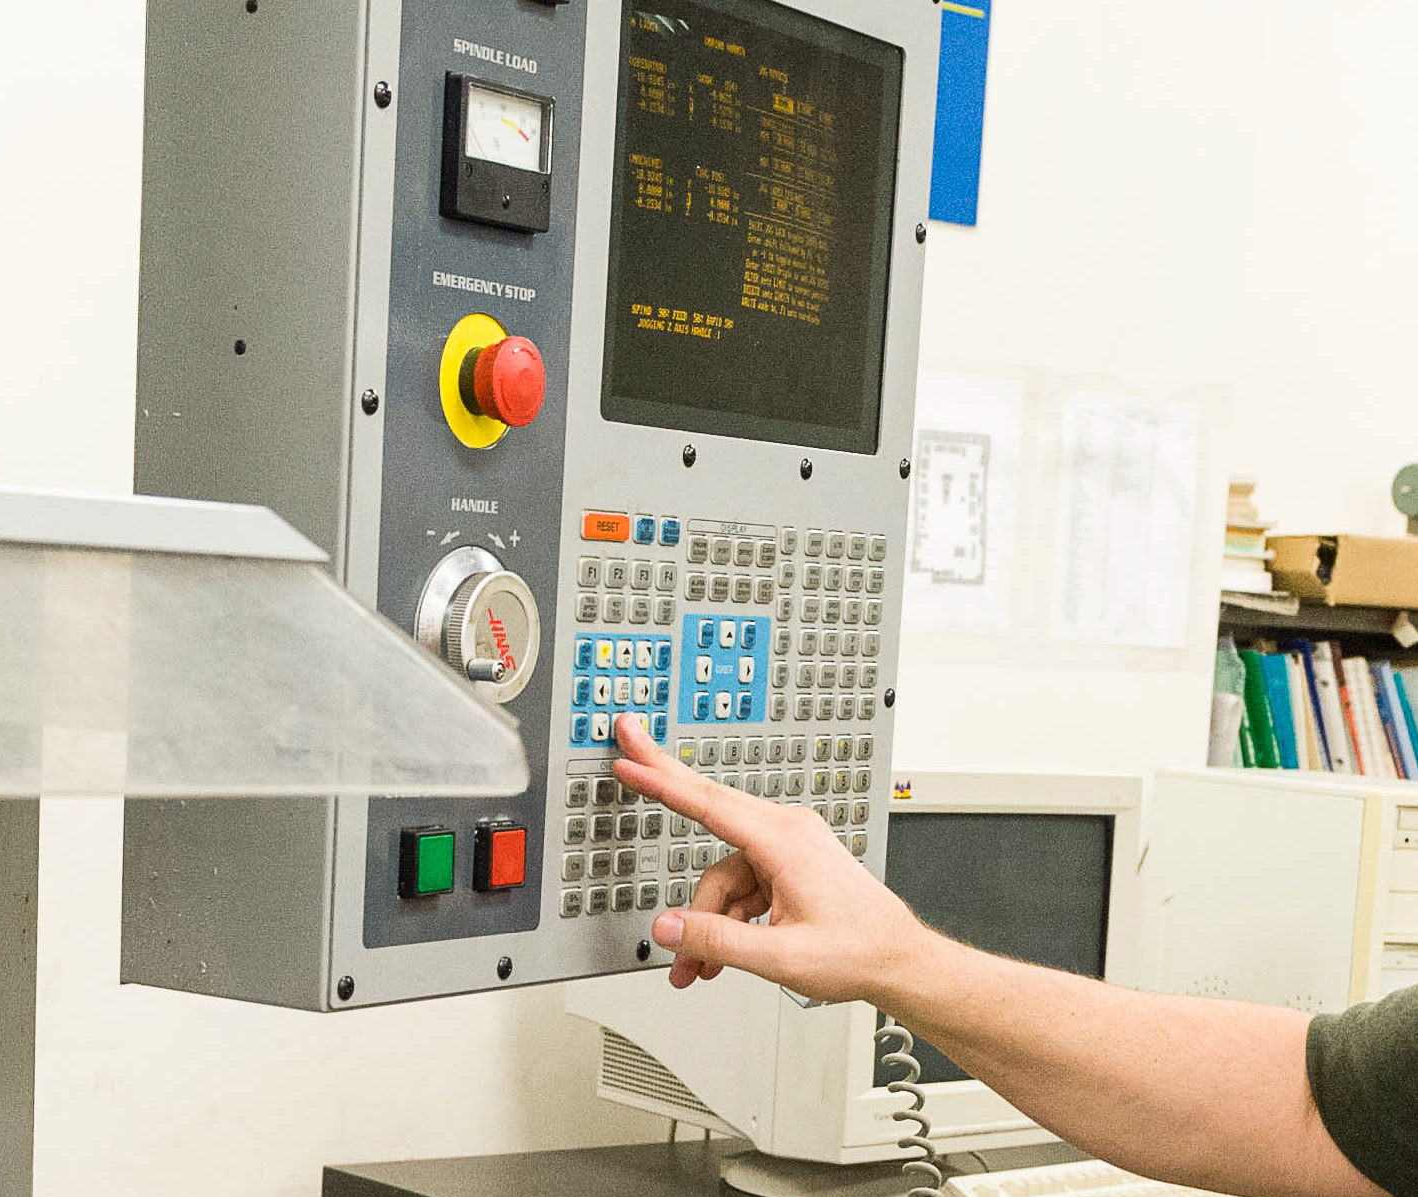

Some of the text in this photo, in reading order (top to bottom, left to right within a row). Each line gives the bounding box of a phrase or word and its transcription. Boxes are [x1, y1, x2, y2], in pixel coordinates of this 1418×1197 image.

[453, 37, 538, 75] SPINDLE LOAD
[432, 270, 537, 302] EMERGENCY STOP
[451, 498, 499, 515] HANDLE
[596, 520, 621, 533] RESET
[720, 523, 748, 534] DISPLAY
[588, 566, 597, 579] F1
[613, 567, 624, 580] F2
[640, 569, 649, 581] F3
[664, 571, 673, 582] F4
[708, 748, 715, 758] A
[731, 746, 737, 757] B
[753, 746, 760, 757] C
[775, 745, 782, 756] D
[796, 744, 803, 755] E
[821, 743, 828, 755] 7
[842, 742, 849, 755] 8
[863, 742, 869, 754] 9
[774, 778, 780, 789] J
[794, 778, 801, 789] K
[820, 775, 826, 787] 4
[840, 775, 847, 787] 5
[861, 774, 868, 786] 6
[837, 808, 844, 820] 2
[859, 806, 866, 819] 3
[681, 816, 687, 829] L
[678, 851, 685, 864] R
[702, 851, 709, 863] S
[676, 887, 683, 900] X
